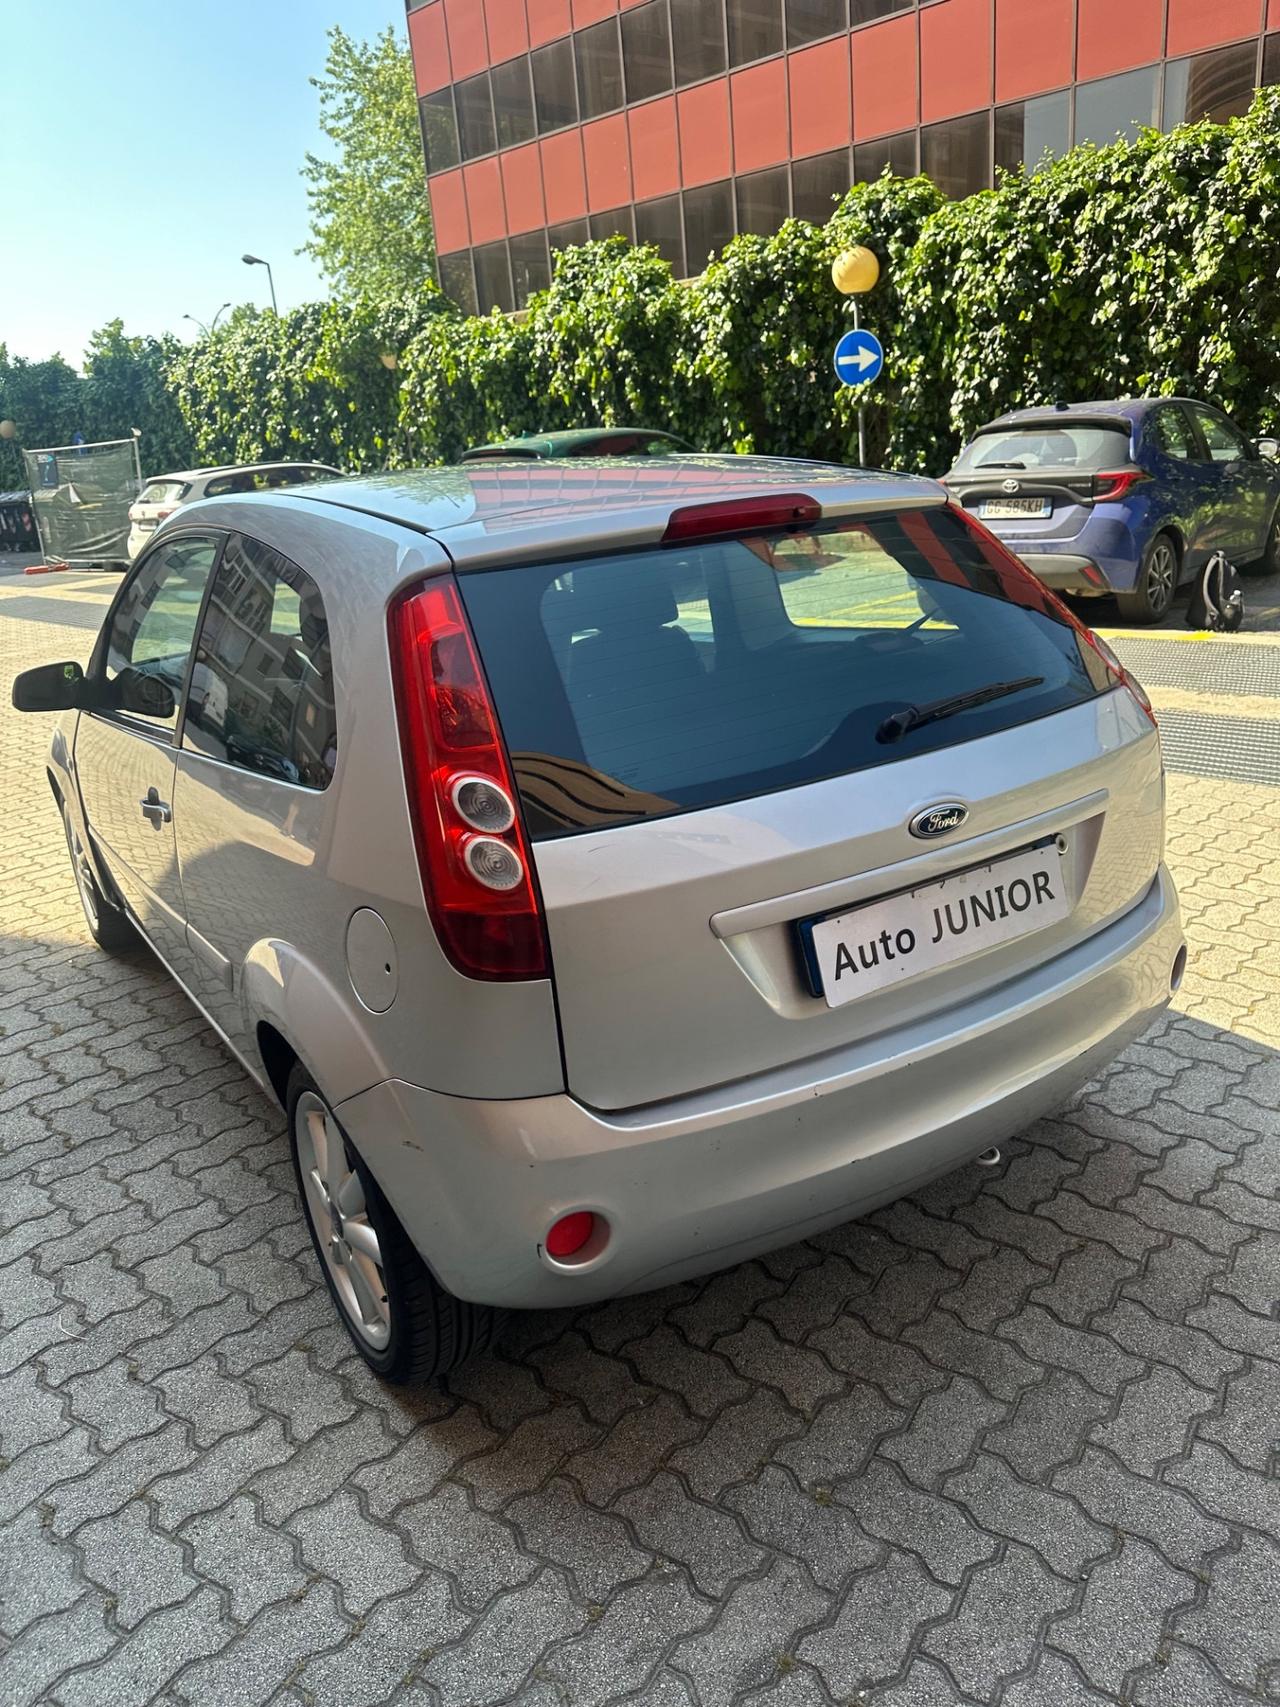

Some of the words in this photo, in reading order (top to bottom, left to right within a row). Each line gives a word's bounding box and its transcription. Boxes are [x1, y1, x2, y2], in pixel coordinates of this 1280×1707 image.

[927, 809, 959, 832] Ford
[834, 928, 916, 981] Auto
[931, 870, 1056, 944] JUNIOR
